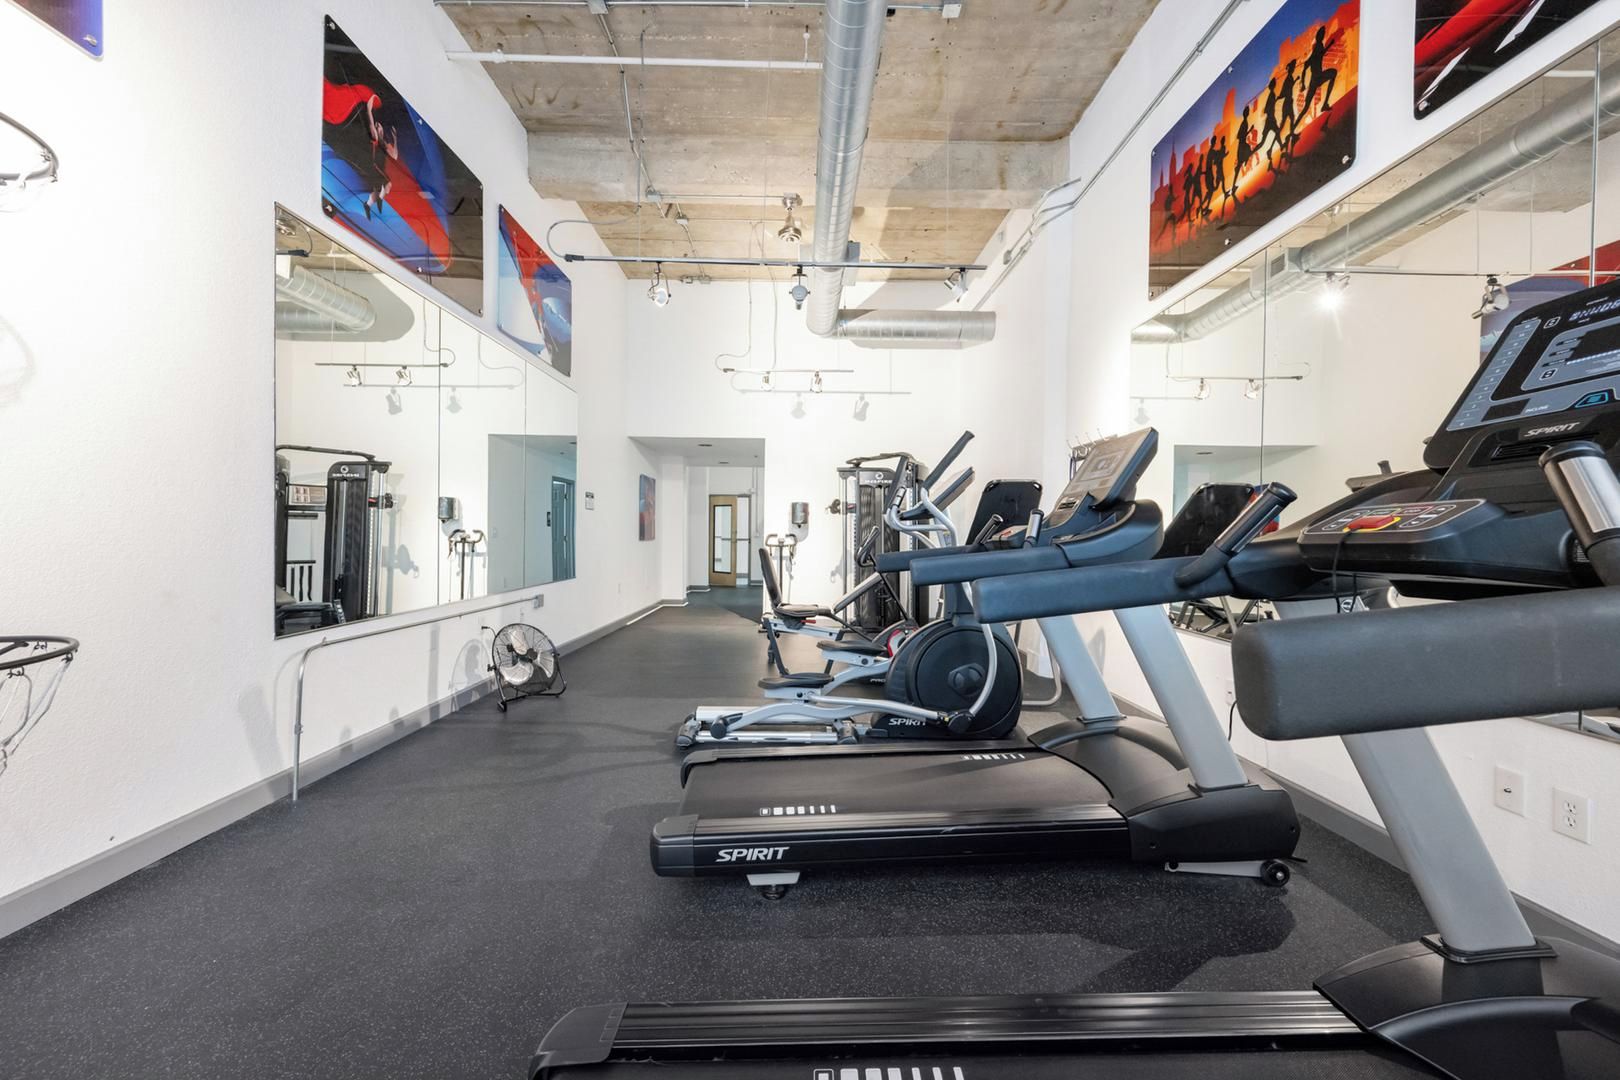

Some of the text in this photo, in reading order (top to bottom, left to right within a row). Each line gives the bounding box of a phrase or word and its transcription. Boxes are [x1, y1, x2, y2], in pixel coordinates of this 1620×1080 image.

[1524, 421, 1580, 437] SPIRIT
[888, 717, 926, 726] SPIRI
[715, 846, 790, 862] SPIRIT
